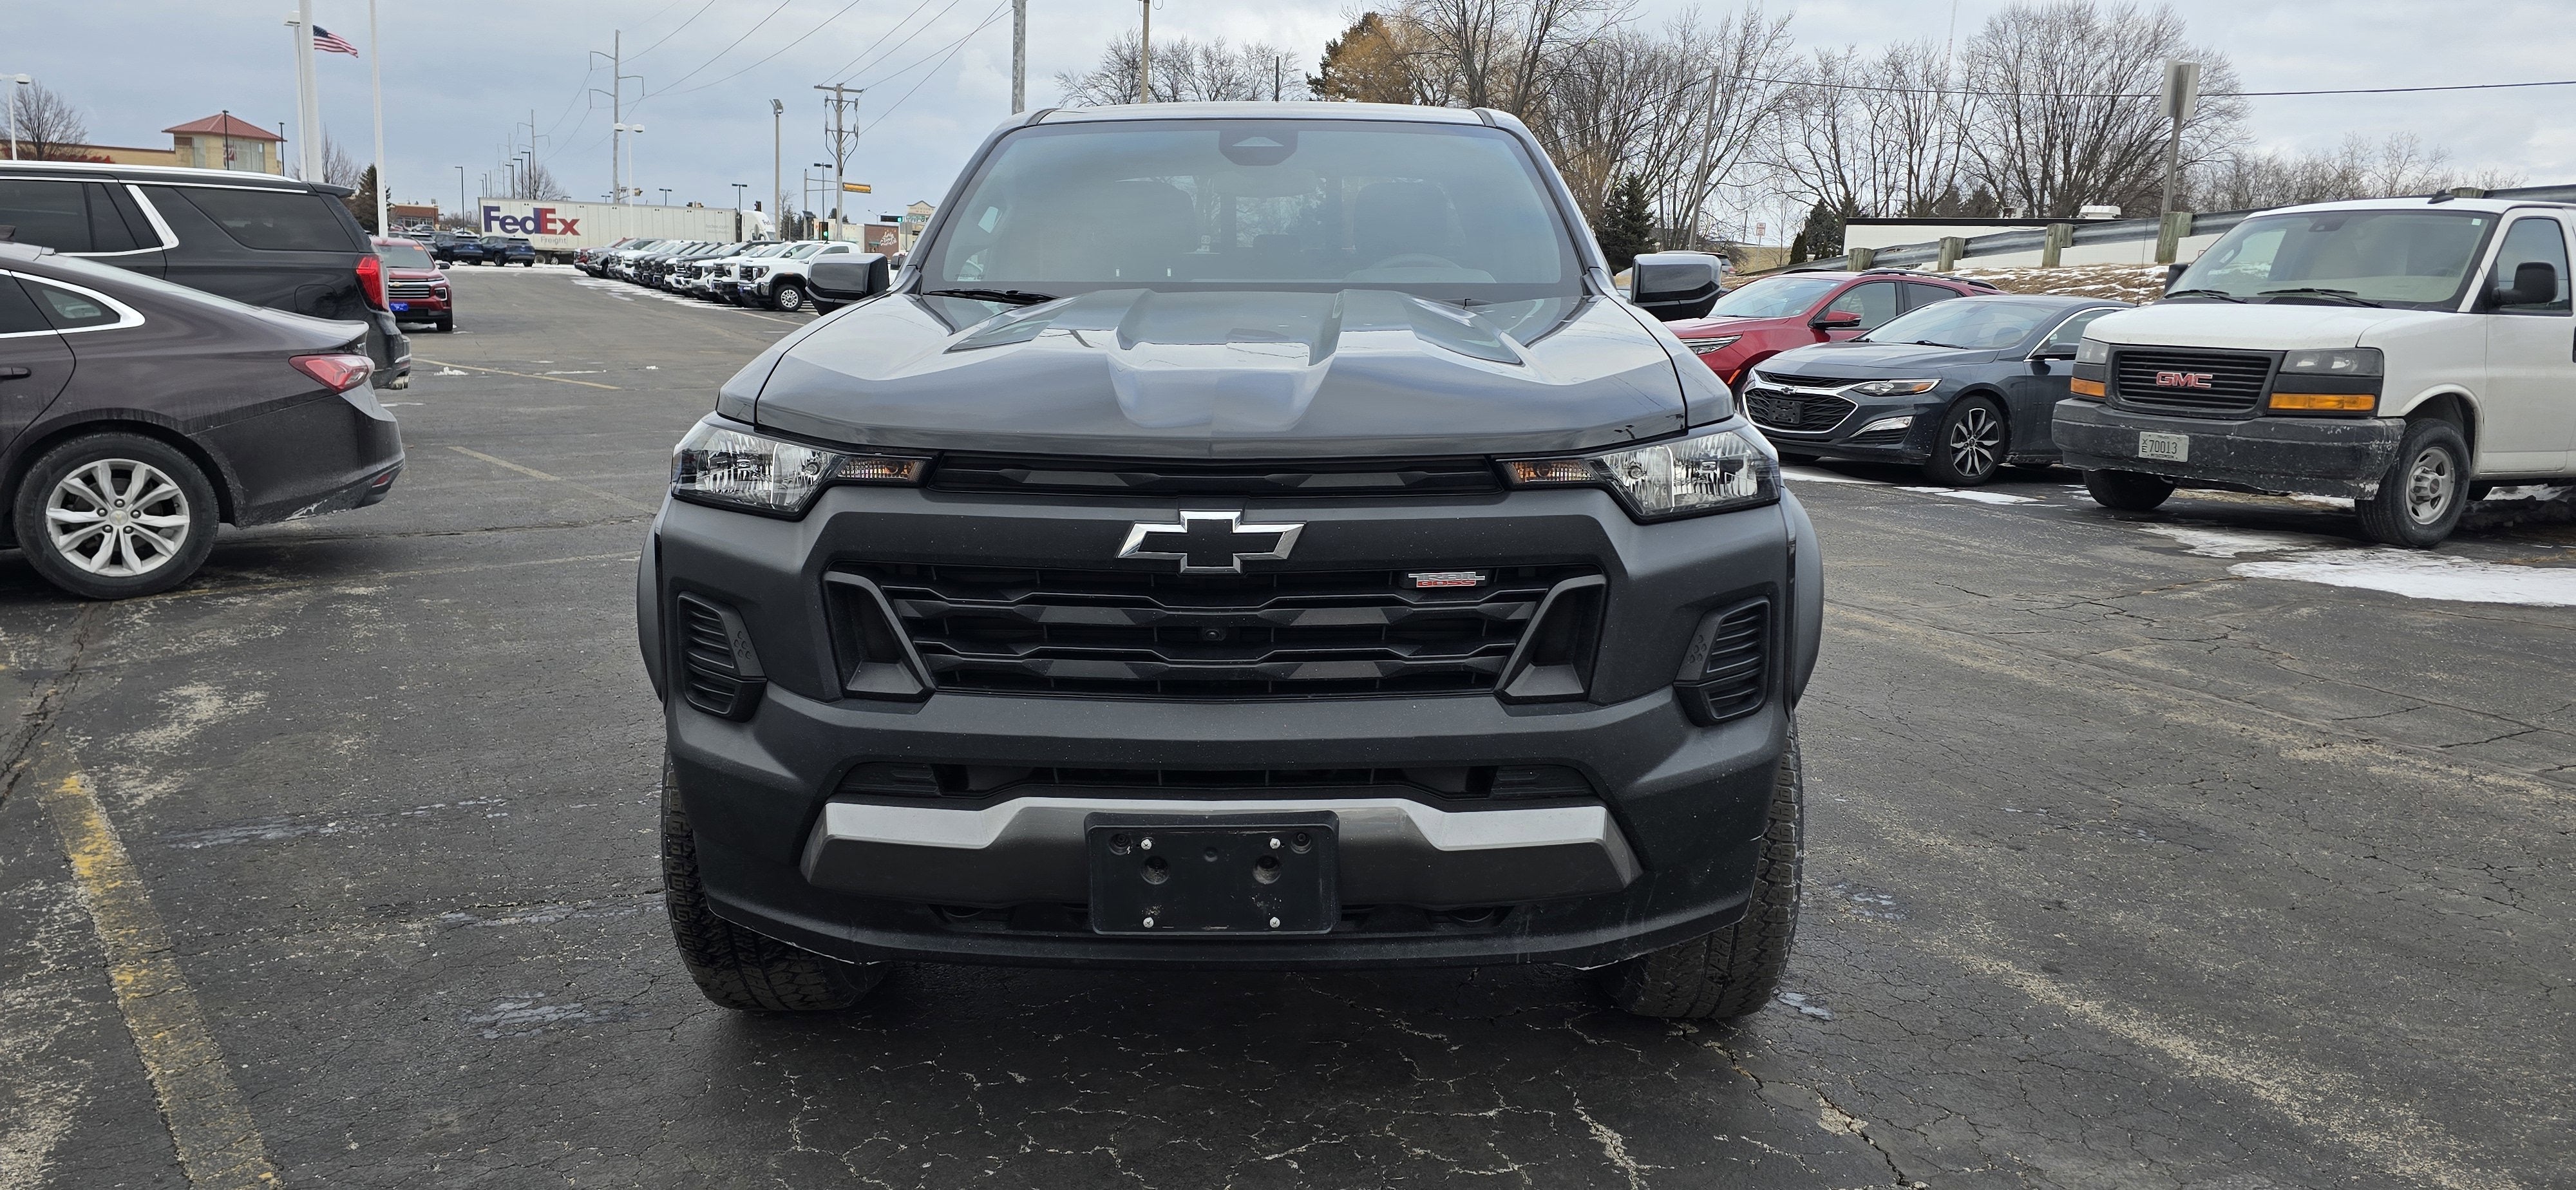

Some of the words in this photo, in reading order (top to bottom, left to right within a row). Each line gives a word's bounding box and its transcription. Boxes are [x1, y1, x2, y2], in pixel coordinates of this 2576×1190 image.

[483, 205, 581, 236] FedEx
[540, 236, 567, 245] Freight
[2156, 372, 2213, 388] GMC
[2149, 439, 2177, 454] 70013
[1408, 571, 1486, 581] TRAIL
